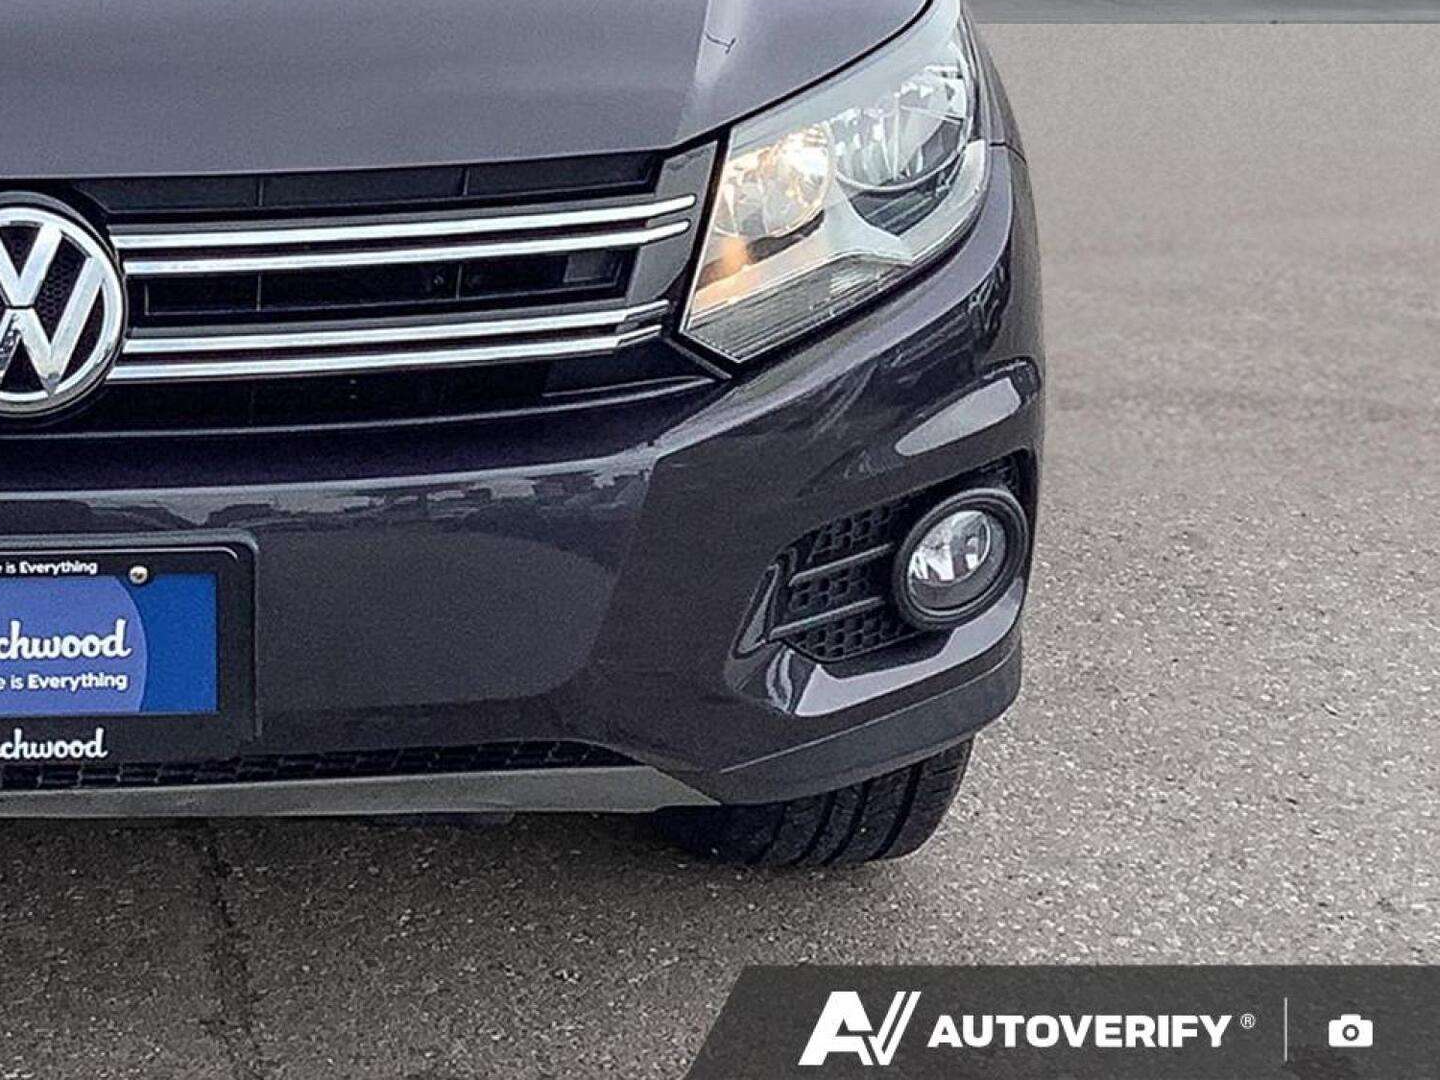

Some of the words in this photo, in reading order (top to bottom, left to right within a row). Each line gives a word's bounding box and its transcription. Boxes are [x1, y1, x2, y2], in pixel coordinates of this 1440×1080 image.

[5, 561, 17, 574] is
[19, 560, 98, 575] Everything
[10, 674, 24, 691] is
[27, 672, 128, 693] Everything
